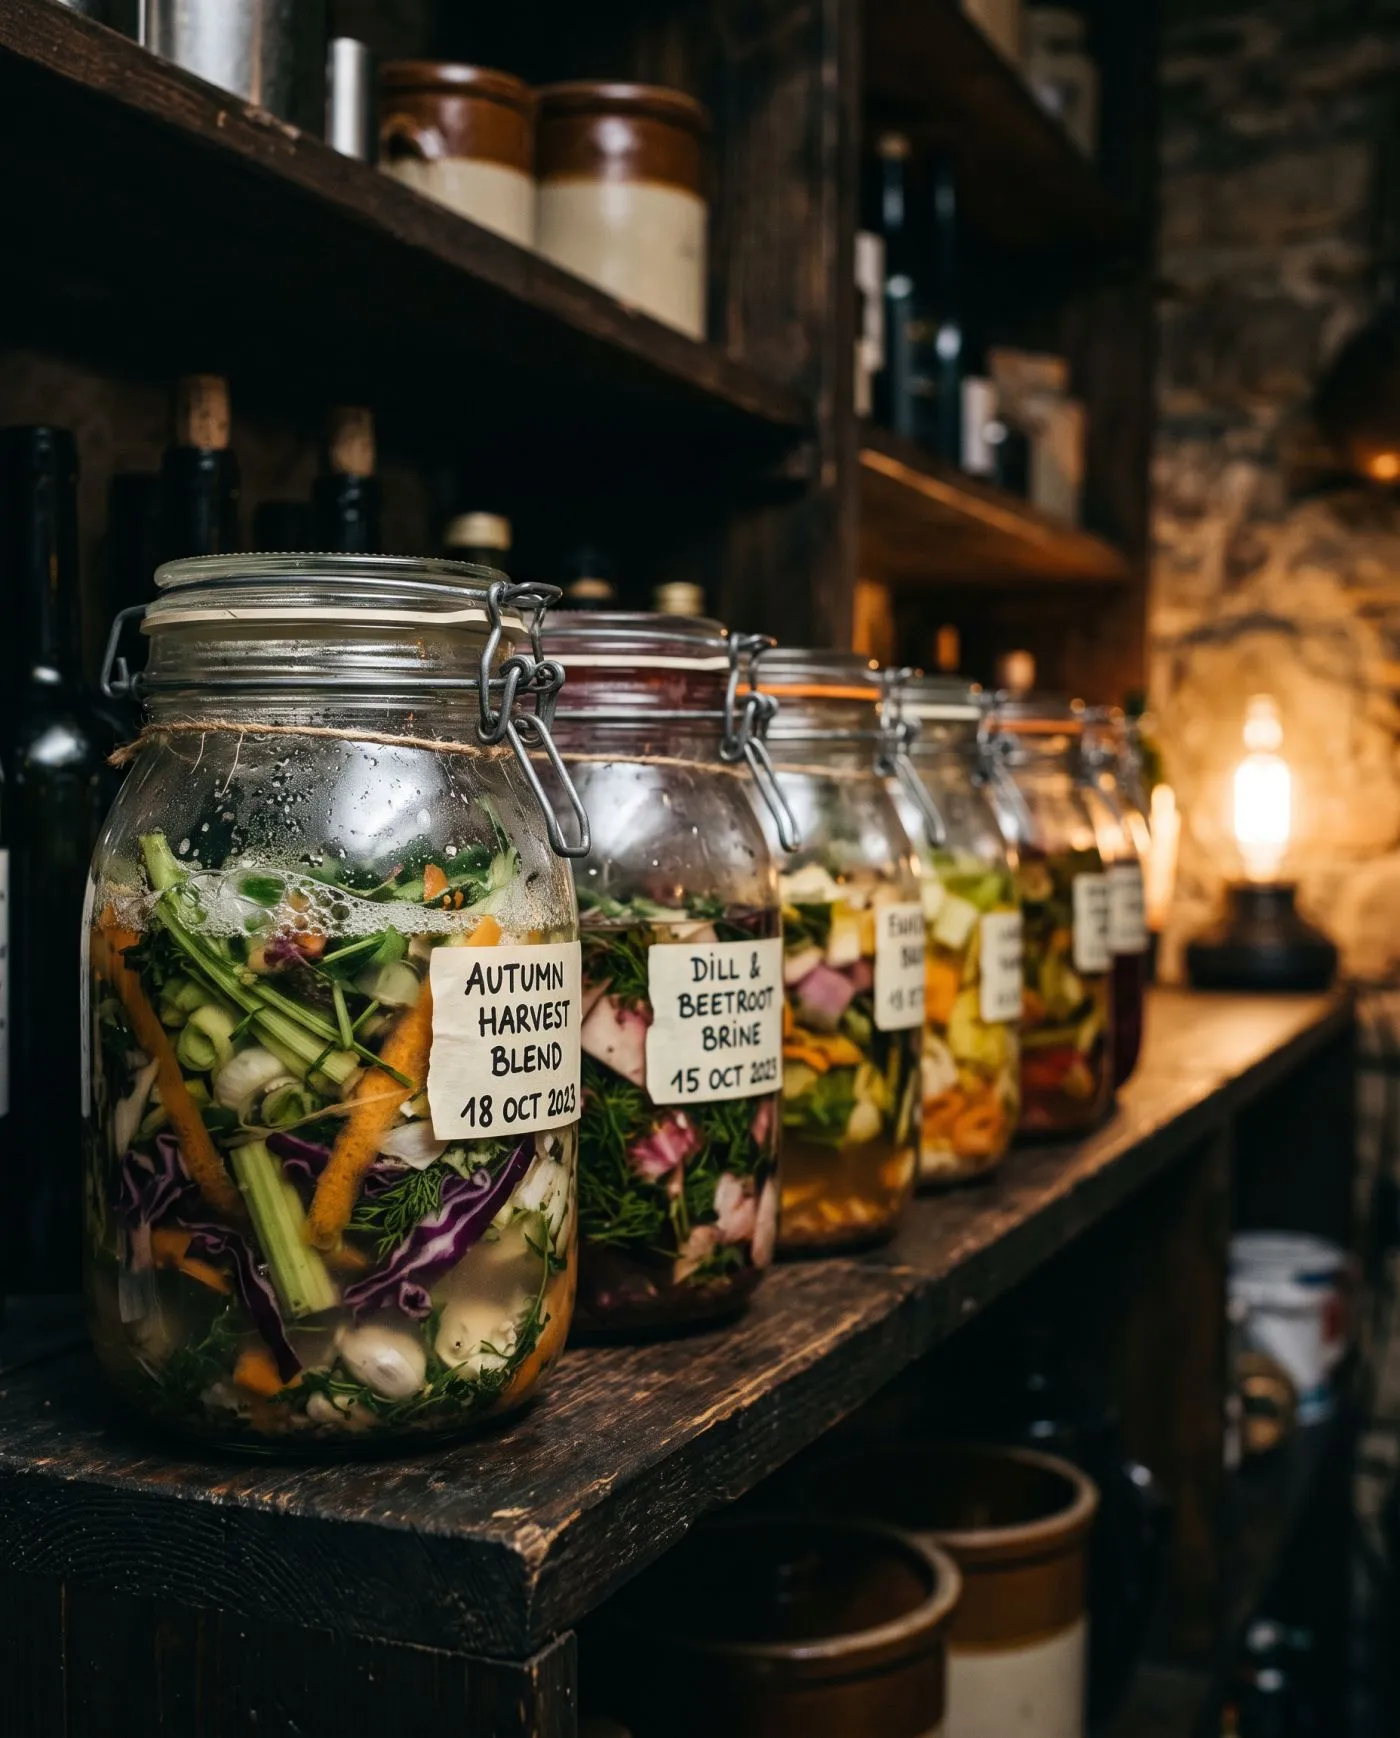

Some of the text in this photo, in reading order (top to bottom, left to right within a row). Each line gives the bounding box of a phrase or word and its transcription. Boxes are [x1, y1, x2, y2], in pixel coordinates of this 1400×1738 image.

[464, 961, 564, 996] AUTUMN
[749, 951, 761, 979] &
[478, 999, 571, 1037] HARVEST
[677, 986, 775, 1019] BEETROOT
[490, 1041, 562, 1077] BLEND
[670, 1067, 700, 1094] 15
[708, 1064, 745, 1090] OCT
[460, 1083, 576, 1128] 18 OCT 2023
